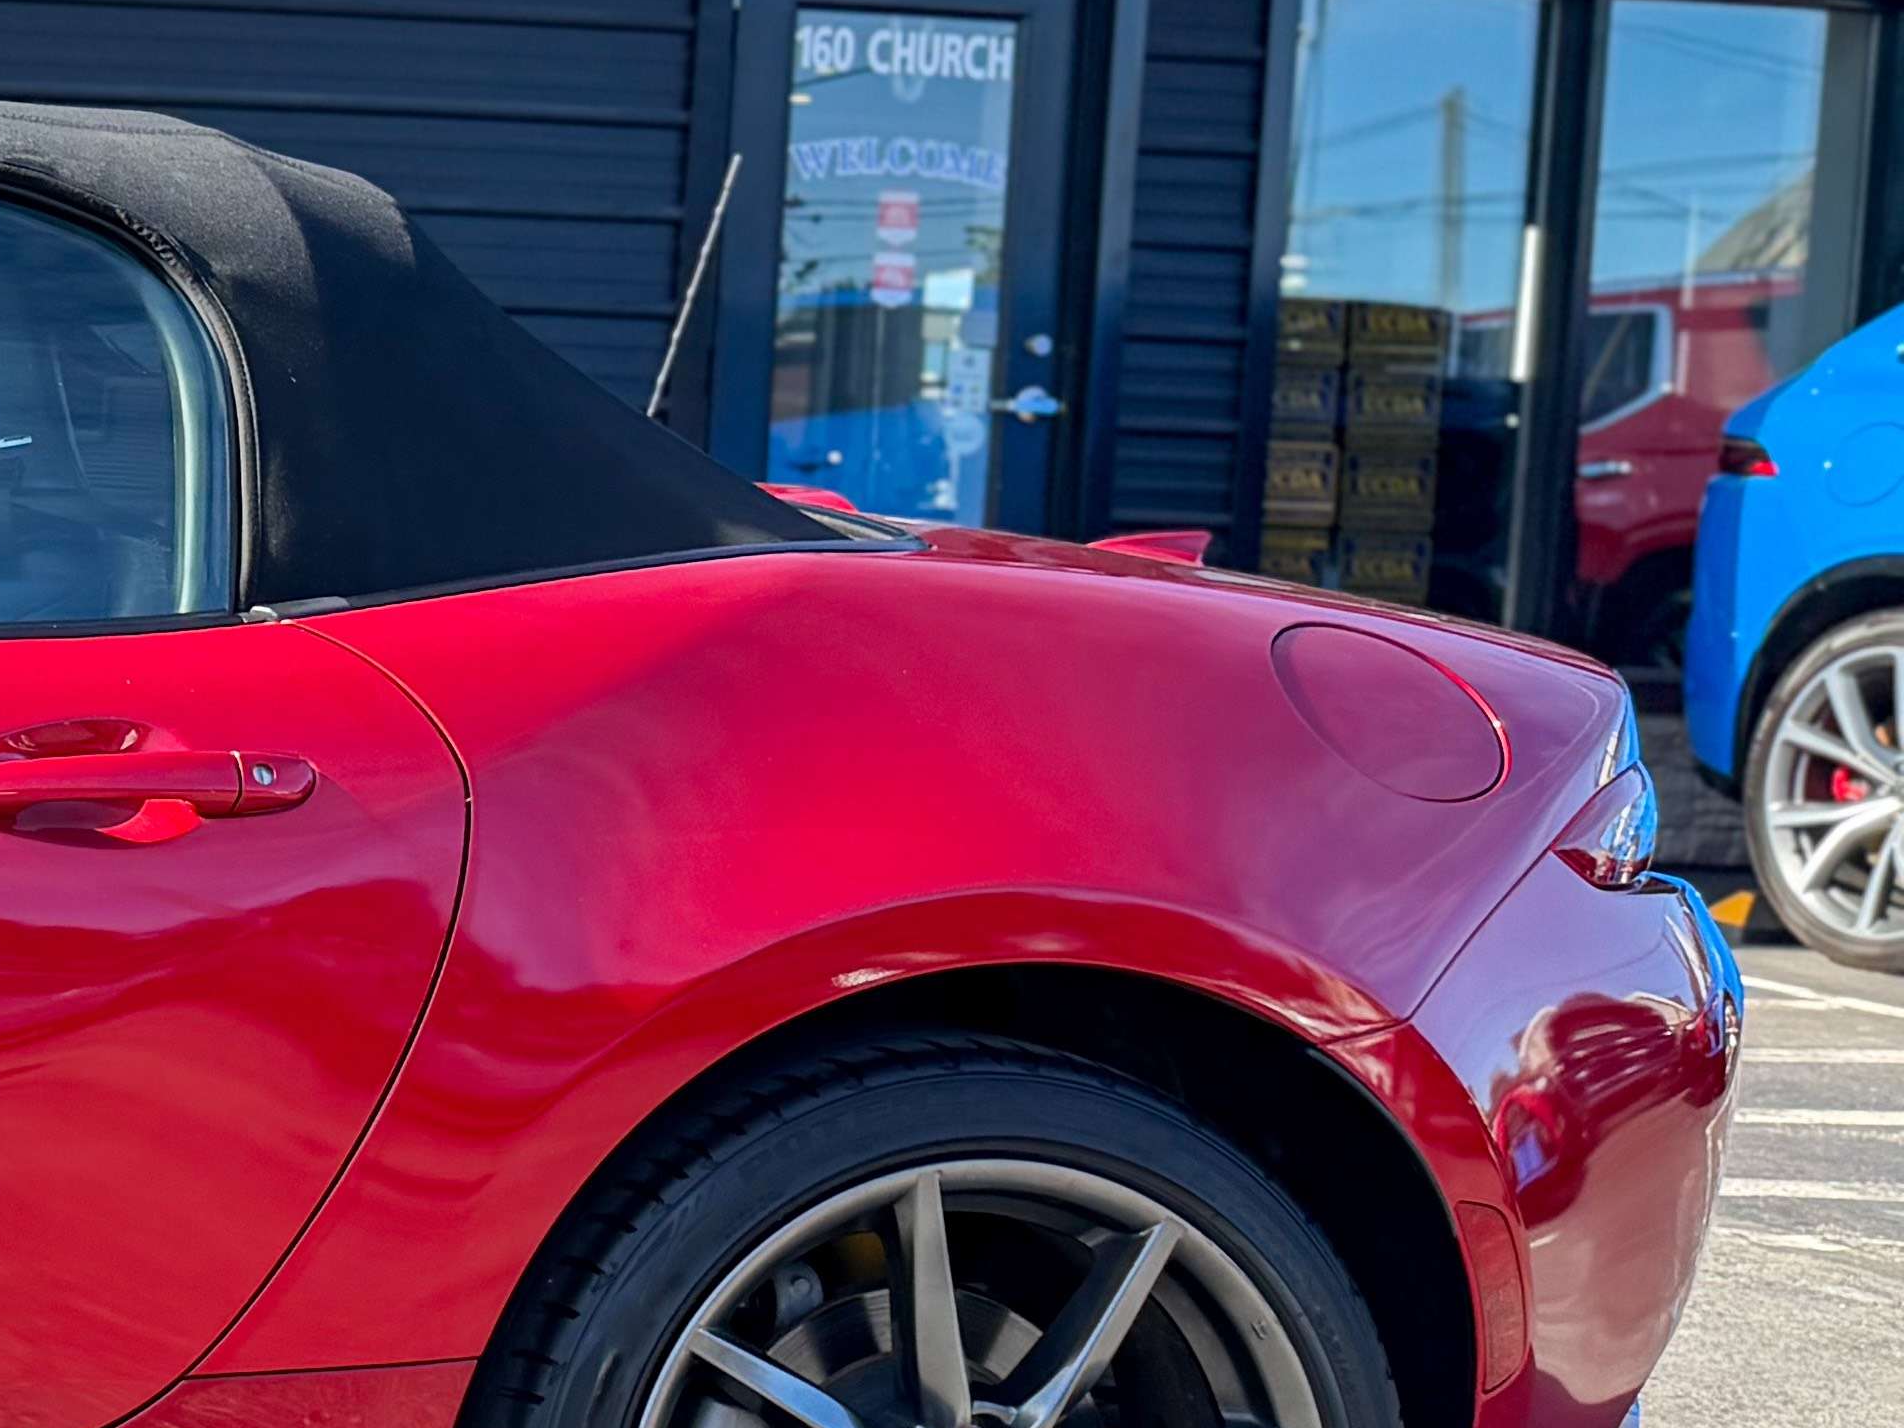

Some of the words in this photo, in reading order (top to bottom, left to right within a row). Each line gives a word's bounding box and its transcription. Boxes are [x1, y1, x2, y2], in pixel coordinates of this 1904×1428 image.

[795, 25, 855, 73] 160
[867, 28, 1016, 81] CHURCH
[789, 136, 1007, 189] WELCOME
